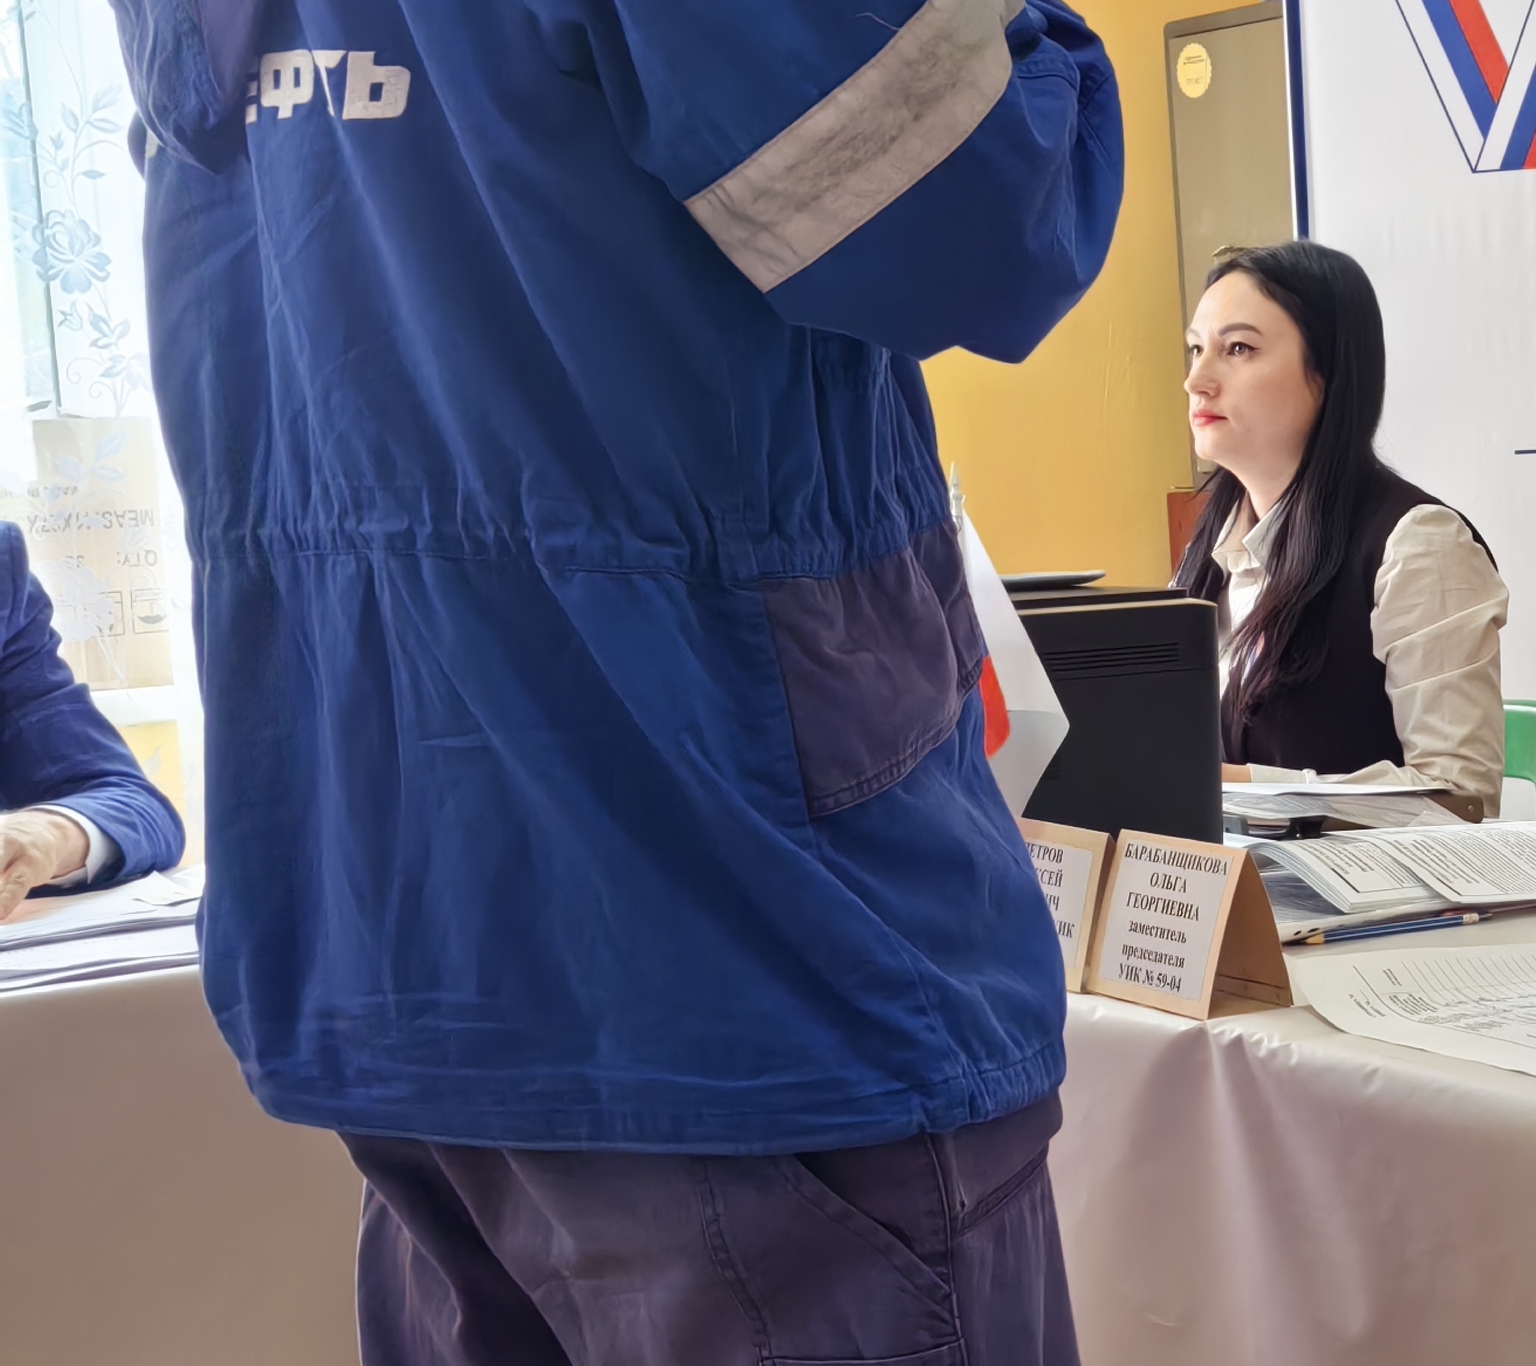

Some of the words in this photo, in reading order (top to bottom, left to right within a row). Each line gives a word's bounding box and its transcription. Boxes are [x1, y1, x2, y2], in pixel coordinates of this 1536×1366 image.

[1124, 843, 1228, 876] БАРАБАНЩИКОВА
[1149, 872, 1187, 894] ОЛЬГА
[1126, 891, 1200, 922] ГЕОРГИЕВНА
[1128, 921, 1187, 944] заместитель
[1121, 943, 1186, 970] председателя
[1118, 962, 1143, 985] УИК
[1155, 971, 1182, 994] 59-04
